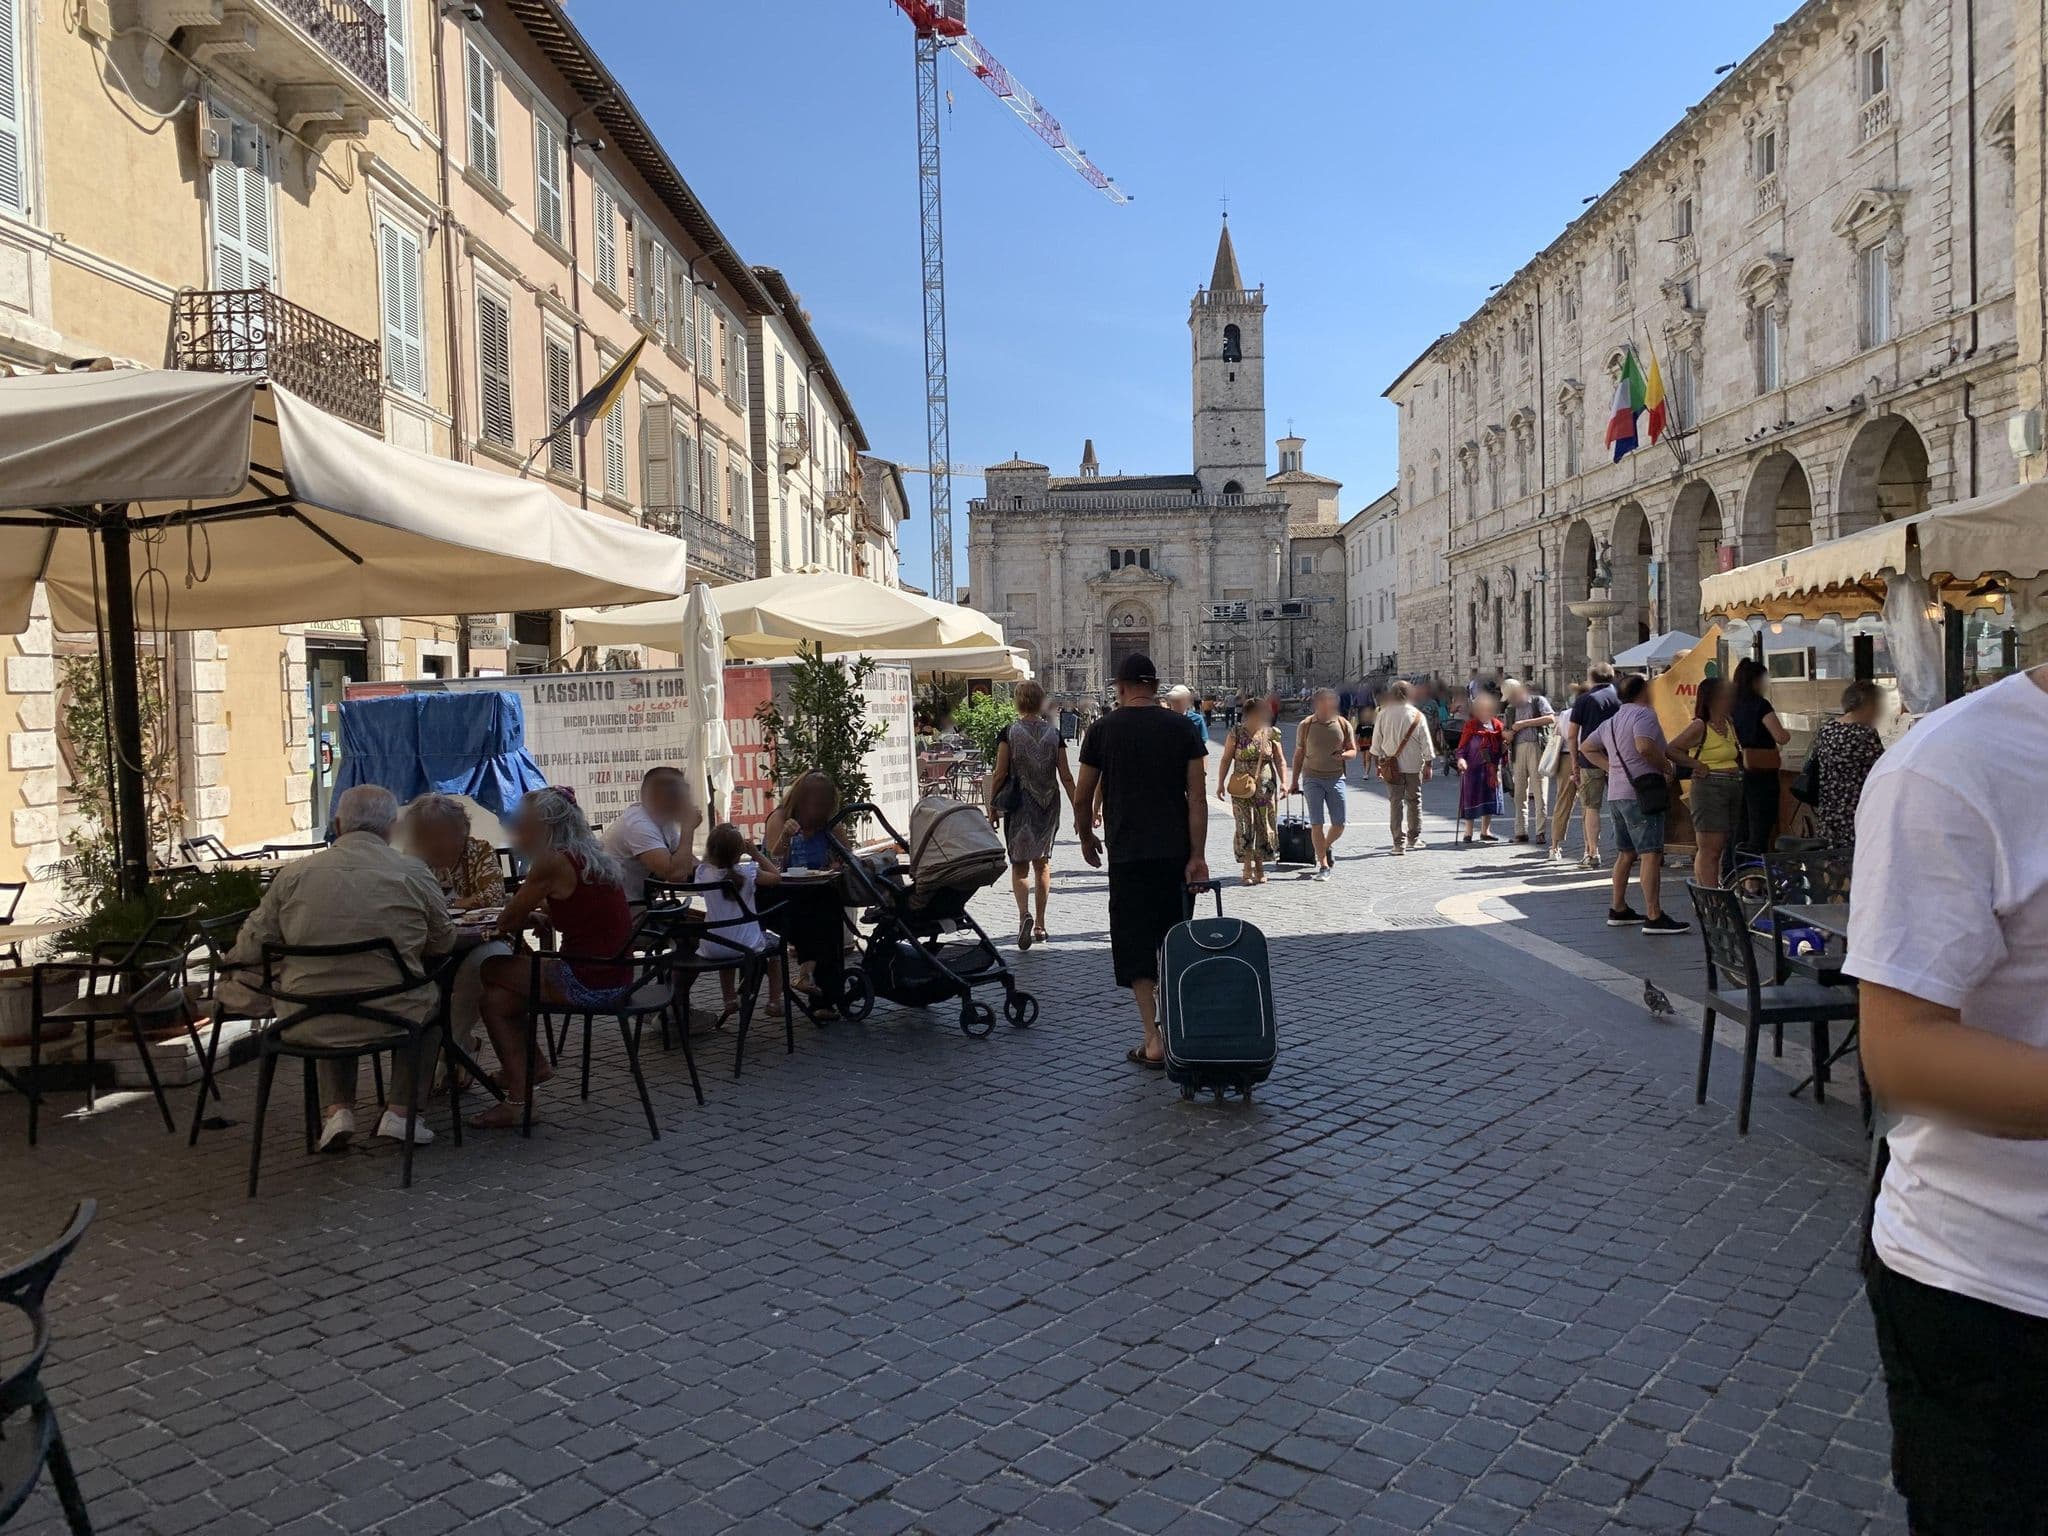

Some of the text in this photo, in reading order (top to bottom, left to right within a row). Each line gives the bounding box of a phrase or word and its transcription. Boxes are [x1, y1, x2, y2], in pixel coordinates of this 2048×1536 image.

[533, 681, 615, 704] L'ASSALTO
[657, 678, 688, 698] FOR
[552, 752, 573, 766] PANE
[575, 752, 581, 765] A
[583, 750, 610, 764] PASTA
[645, 748, 662, 761] CON
[589, 771, 611, 785] PIZZA
[614, 770, 623, 784] IN
